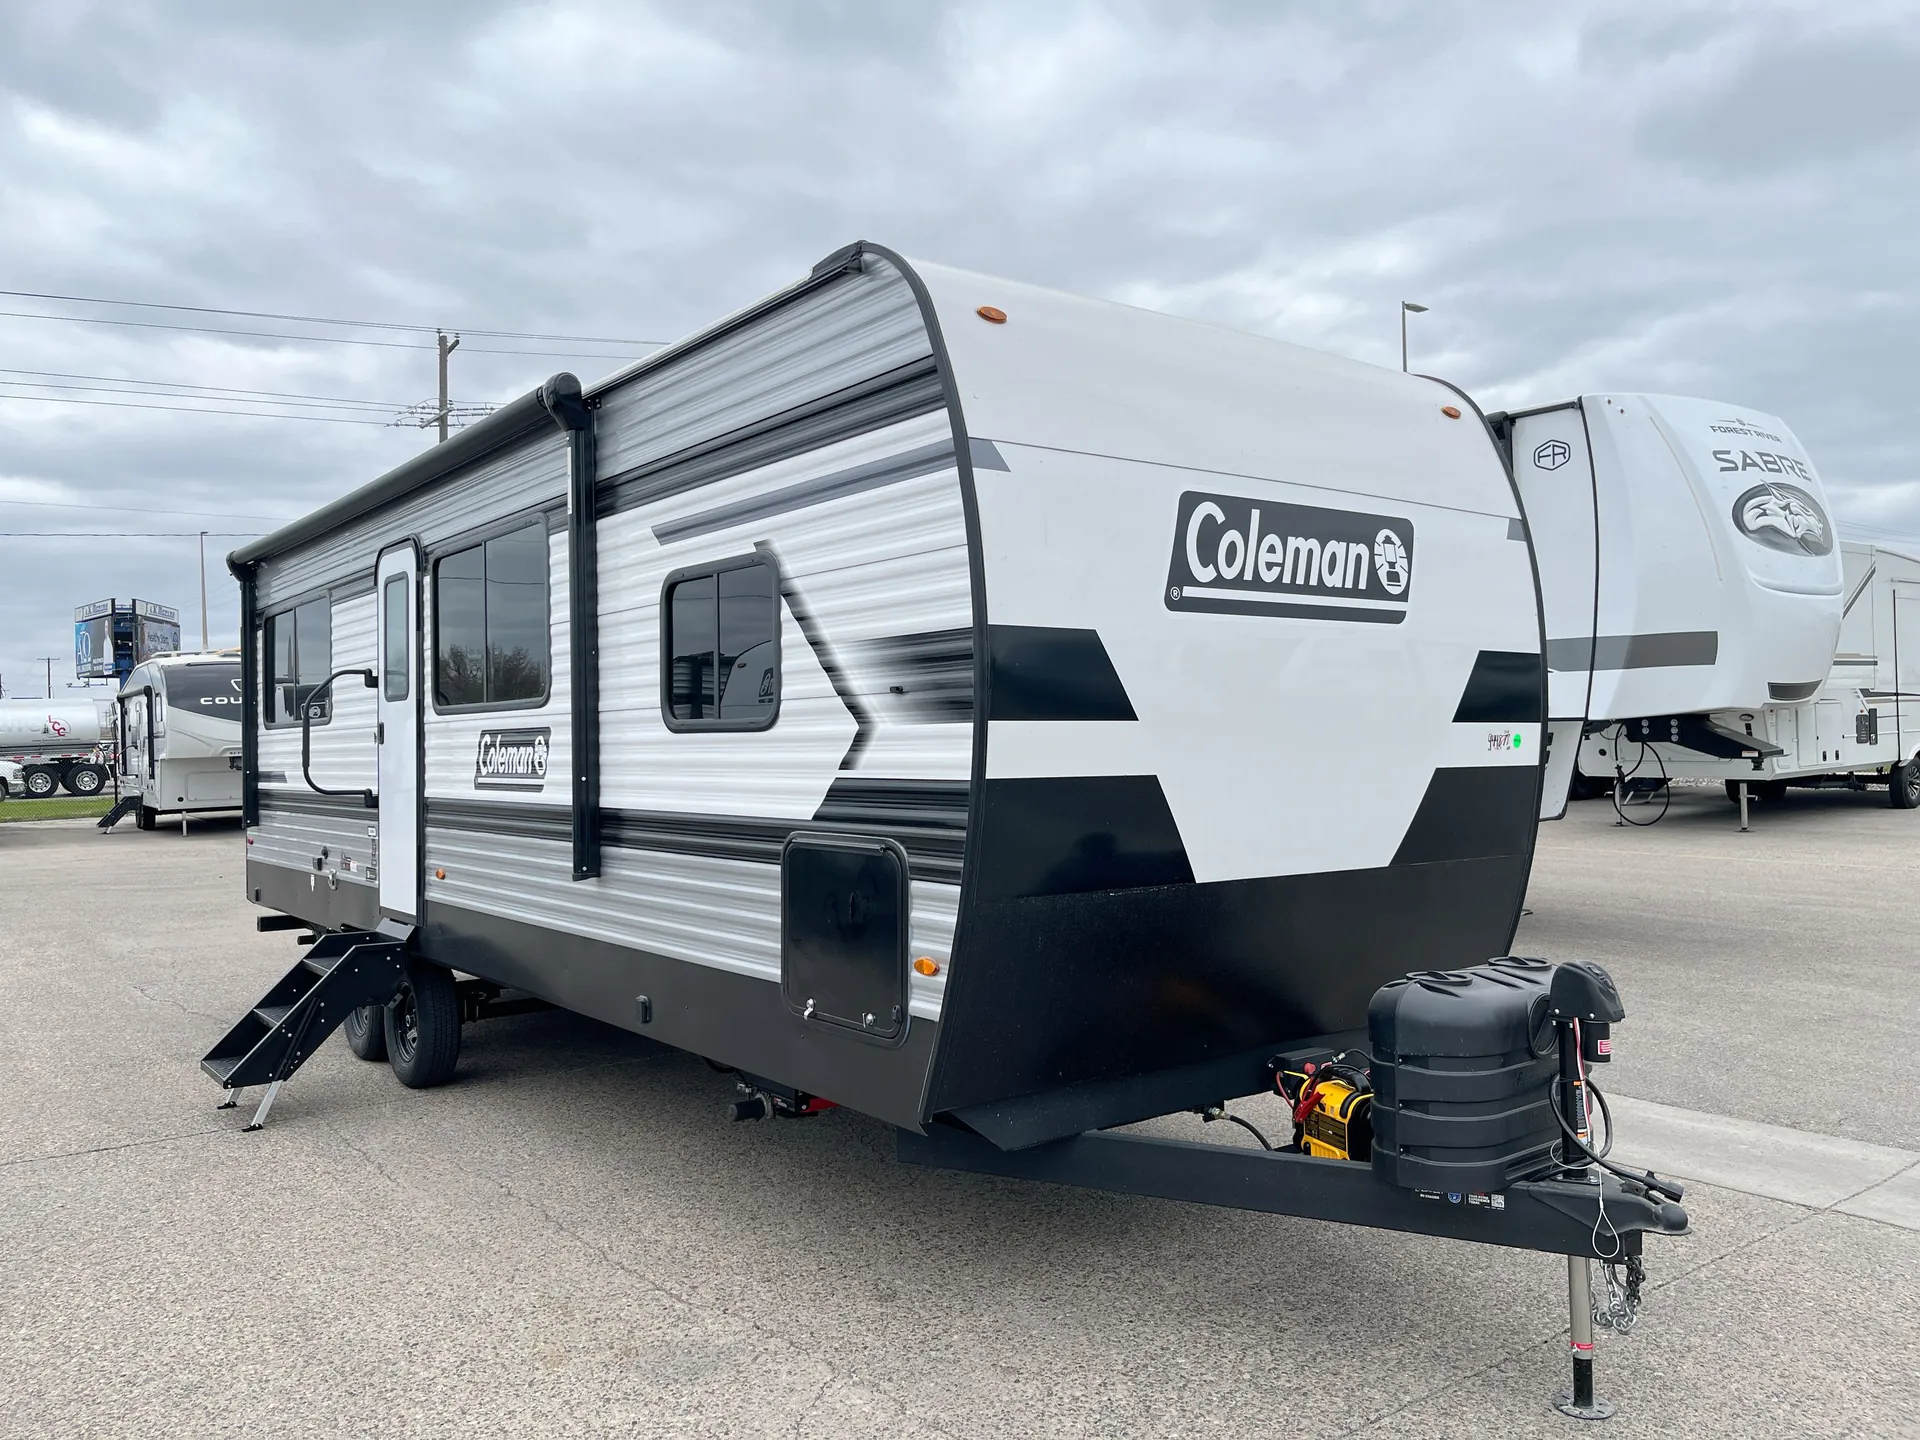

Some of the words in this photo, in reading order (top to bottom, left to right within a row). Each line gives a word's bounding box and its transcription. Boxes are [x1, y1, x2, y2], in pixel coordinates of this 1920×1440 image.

[1709, 425, 1754, 437] FOREST
[1754, 430, 1782, 443] RIVER
[1712, 450, 1812, 482] SABRE
[1186, 501, 1370, 590] Coleman
[48, 714, 66, 736] LCC
[480, 734, 534, 776] Coleman
